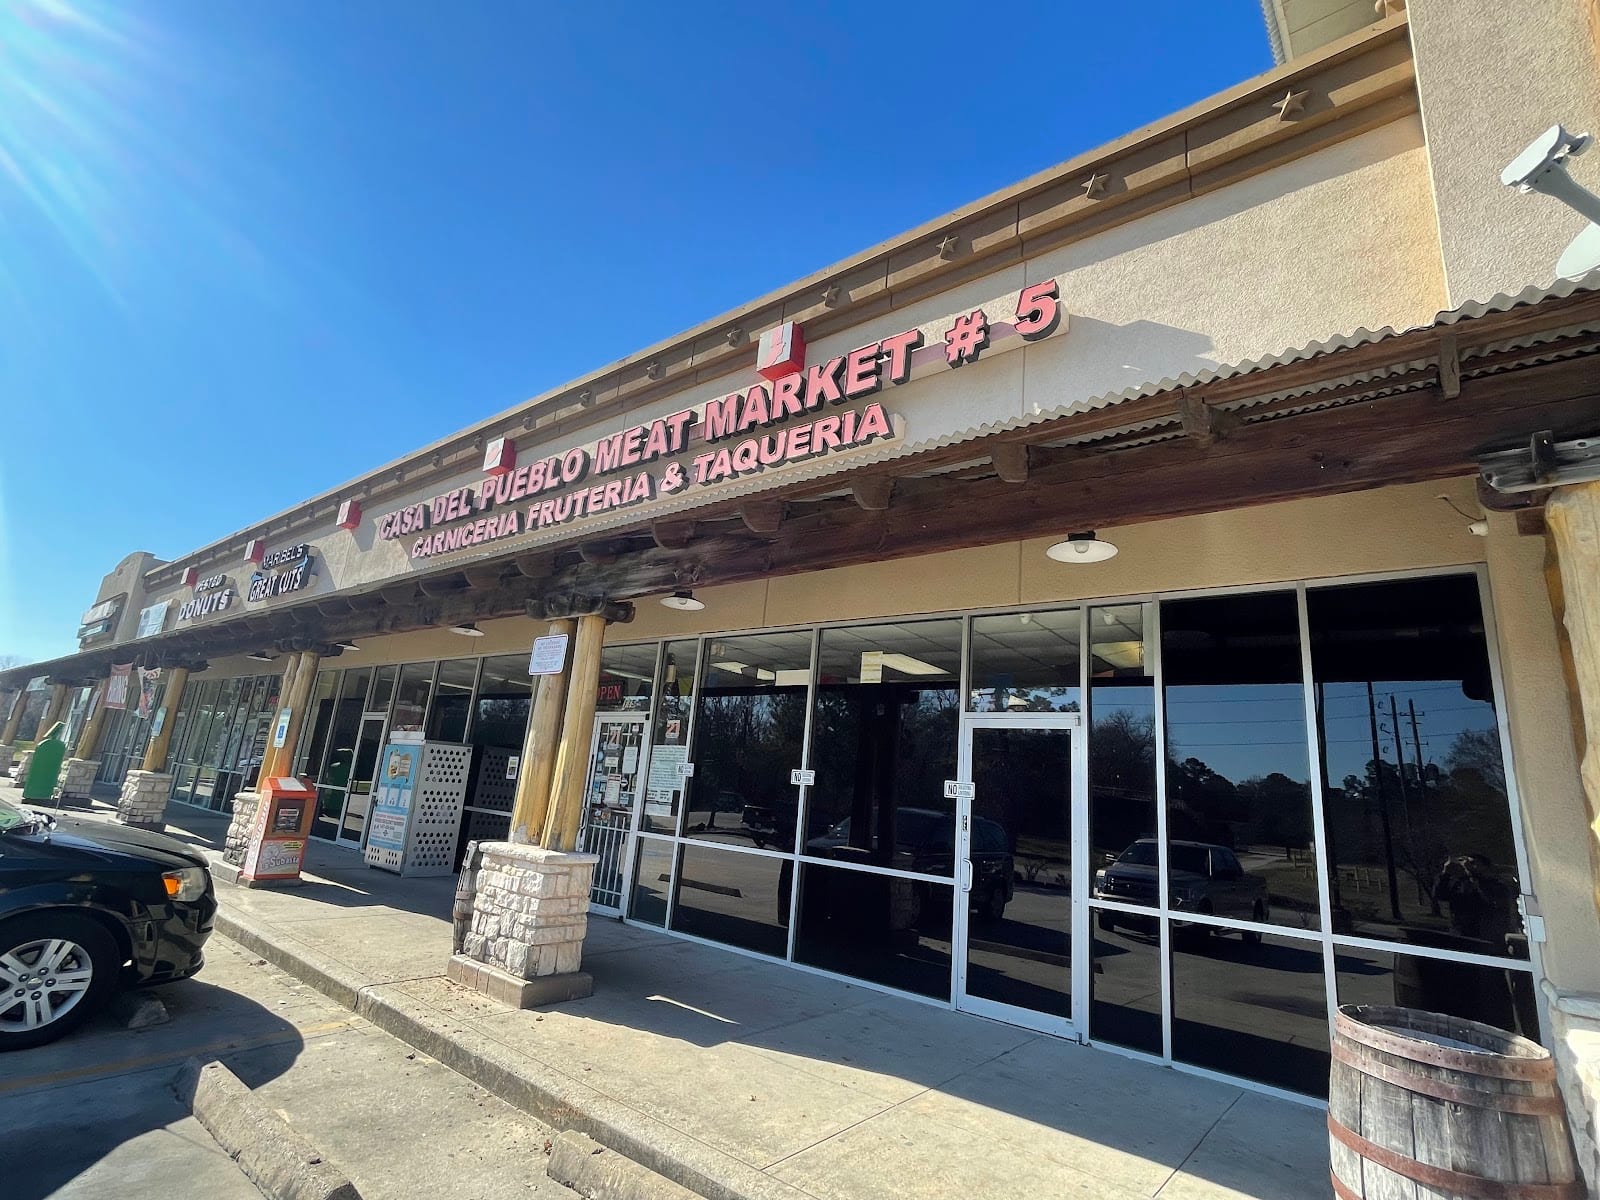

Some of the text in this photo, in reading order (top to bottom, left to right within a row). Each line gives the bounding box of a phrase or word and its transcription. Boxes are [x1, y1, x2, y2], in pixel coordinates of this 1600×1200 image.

[378, 279, 1060, 540] CASA DEL PUEBLO MEAT MARKET # 5
[411, 402, 890, 559] CARNICERIA FRUTERIA & TAQUERIA
[249, 566, 303, 601] GREAT CUTS
[178, 588, 231, 621] DONUTS
[794, 772, 801, 782] NO
[948, 784, 957, 795] NO
